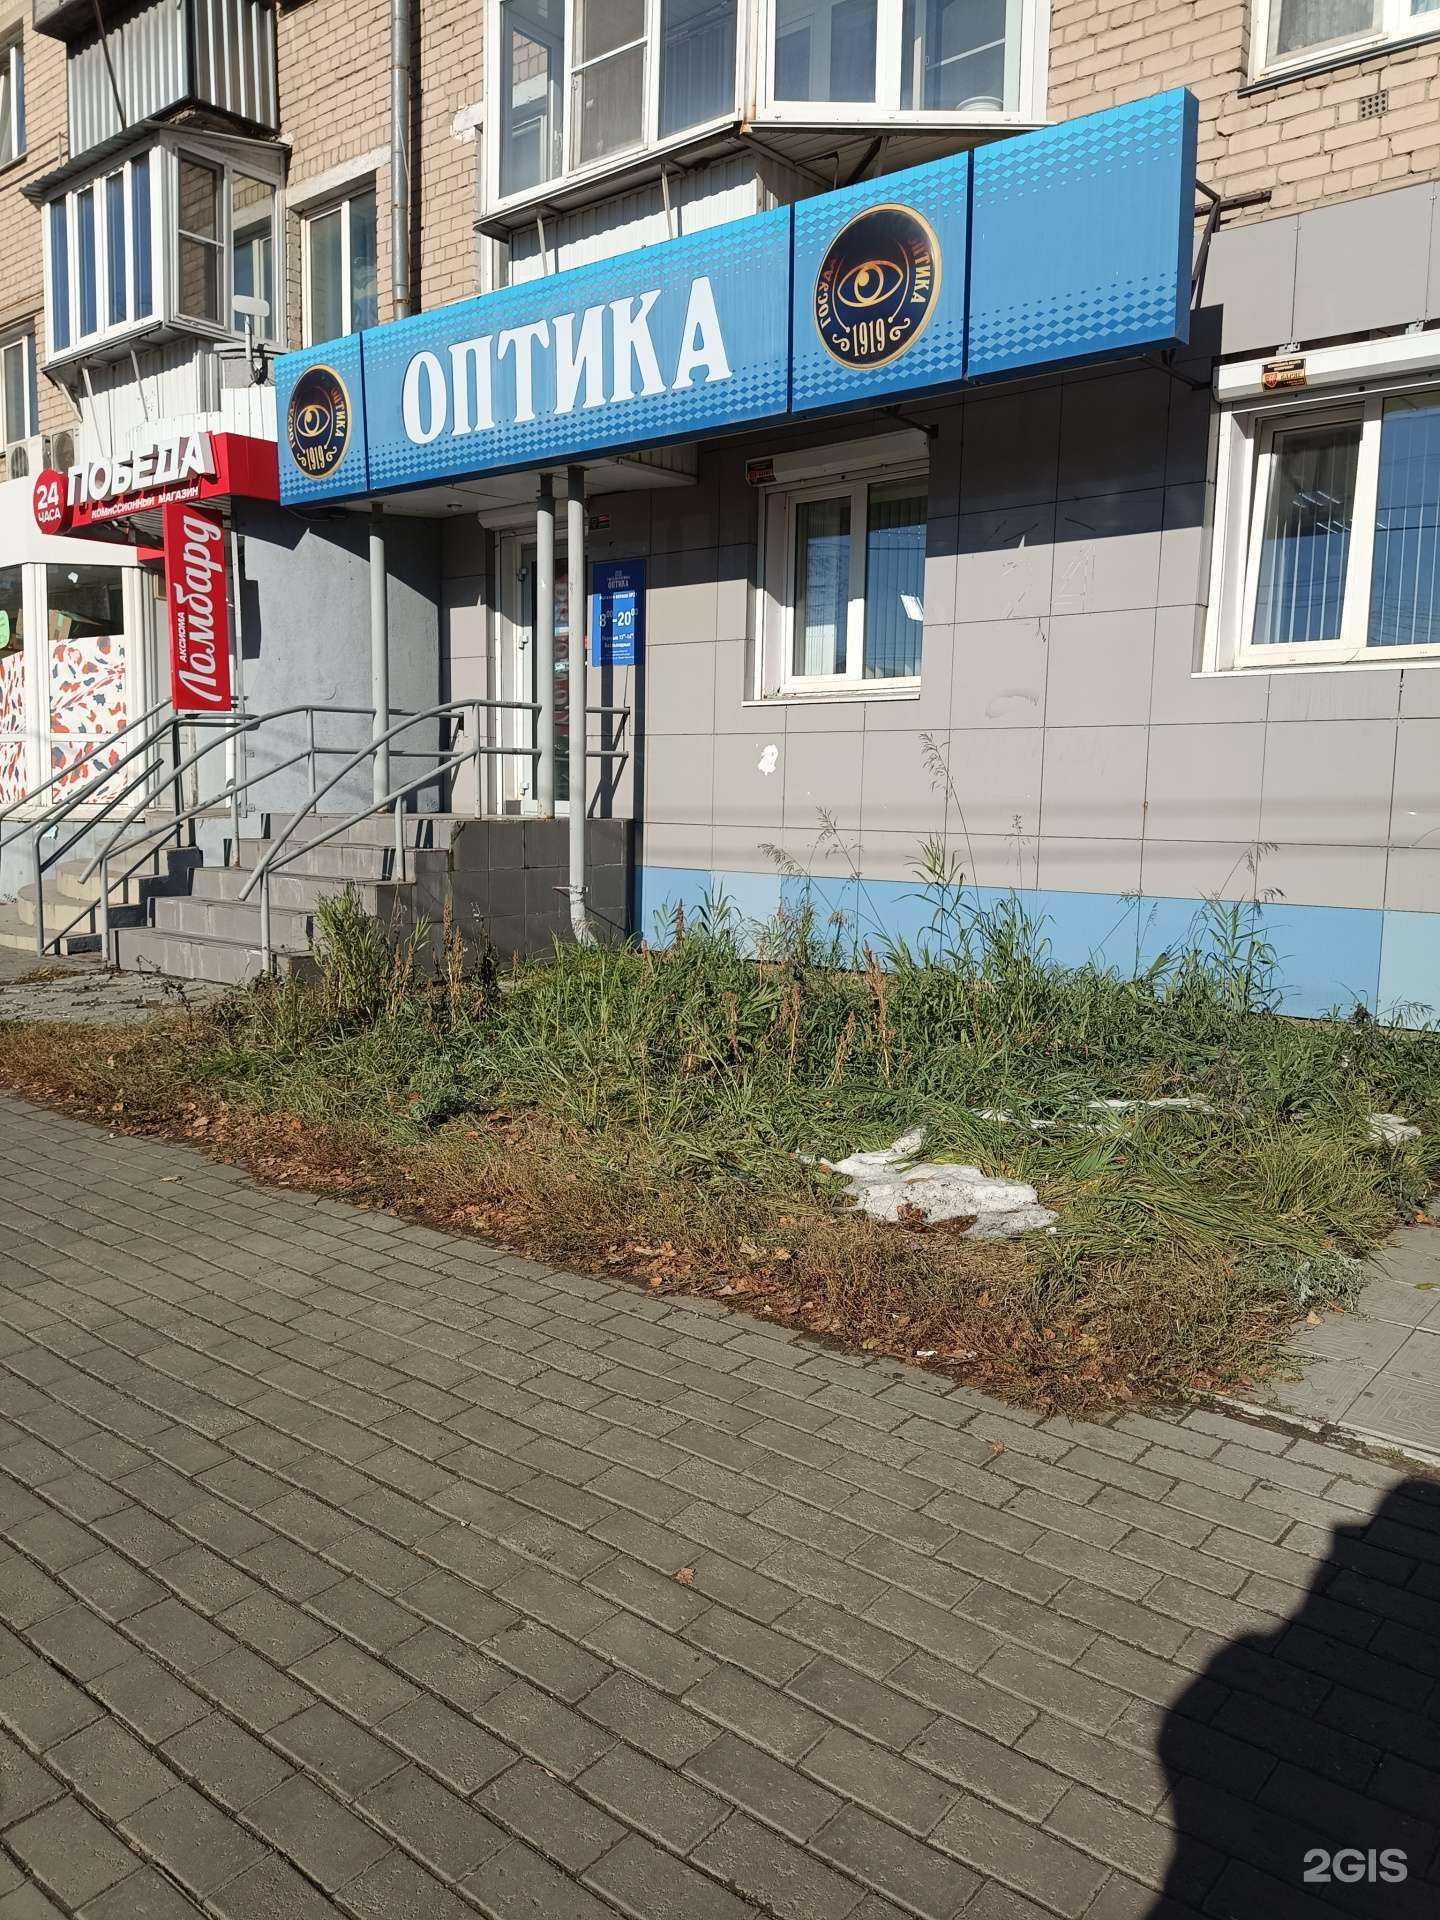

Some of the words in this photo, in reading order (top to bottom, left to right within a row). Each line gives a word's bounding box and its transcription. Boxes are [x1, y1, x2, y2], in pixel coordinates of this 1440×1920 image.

[852, 318, 886, 357] 1919
[402, 276, 733, 445] ОПТИКА
[67, 431, 208, 507] ПОБЕДА
[306, 445, 326, 471] 1919
[36, 482, 59, 510] 24
[38, 508, 62, 522] ЧАСА
[158, 487, 199, 504] МАГАЗИН
[173, 515, 222, 702] Ломбард
[177, 611, 187, 663] АКСИОМА
